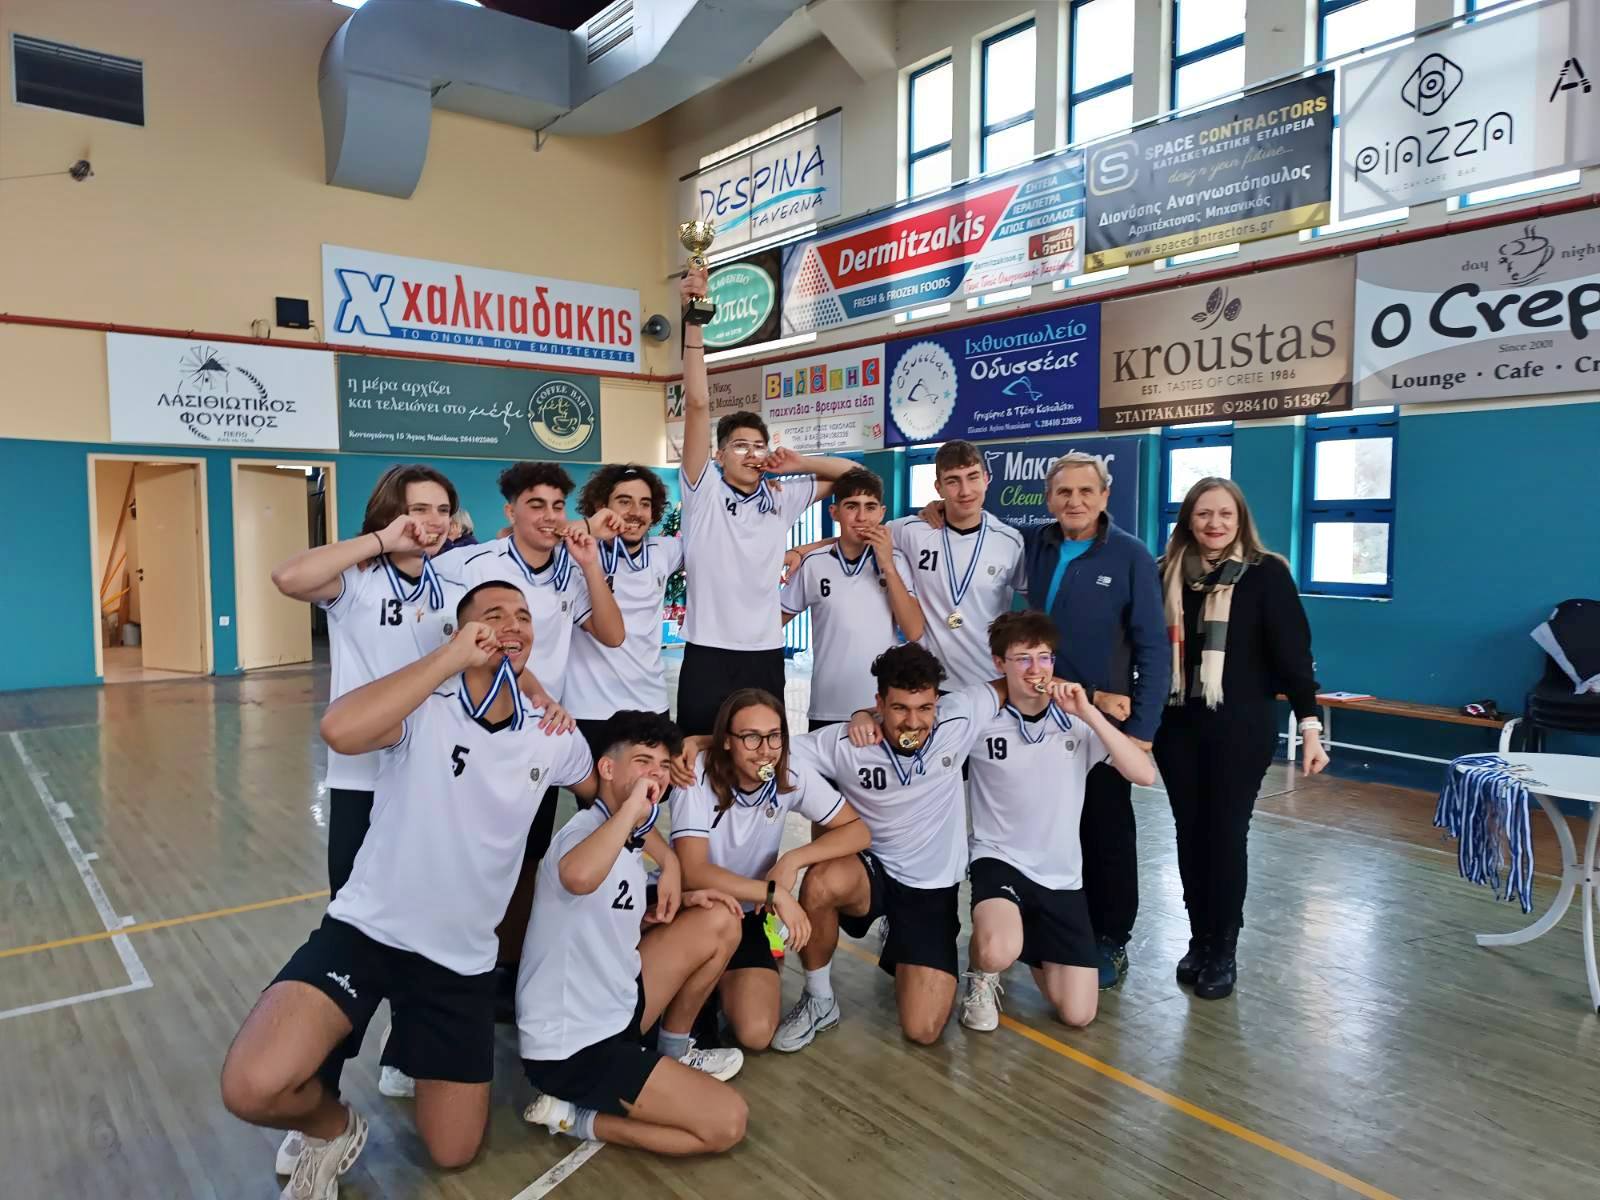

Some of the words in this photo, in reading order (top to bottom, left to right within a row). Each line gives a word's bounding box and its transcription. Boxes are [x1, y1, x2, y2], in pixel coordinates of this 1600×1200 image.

[1144, 134, 1194, 161] SPACE
[1198, 96, 1328, 145] CONTRACTORS
[1152, 136, 1250, 171] ΚΑΤΑΣΚΕΥΑΣΤΙΚΗ
[1256, 118, 1316, 143] ΕΤΑΙΡΕΙΑ
[699, 145, 825, 221] DESPINA
[1098, 201, 1162, 227] Διονύσης
[1166, 164, 1312, 211] Αναγνωστόπουλος
[752, 194, 824, 228] TAVERNA
[1128, 212, 1201, 237] Αρχιτέκτονας
[1205, 195, 1272, 219] Μηχανικός
[837, 210, 986, 277] Dermitzakis
[1124, 219, 1274, 260] www.spacecontractors.gr
[1461, 260, 1489, 272] day
[853, 293, 878, 308] FRESH
[878, 292, 885, 302] &
[886, 284, 918, 301] FROZEN
[919, 277, 951, 294] FOODS
[402, 328, 420, 341] ΤΟ
[430, 332, 486, 348] ΟΝΟΜΑ
[493, 337, 521, 351] ΠΟΥ
[530, 341, 634, 363] ΕΜΠΙΣΤΕΥΕΣΤΕ
[965, 319, 1087, 355] Ιχθυοπωλείο
[1498, 342, 1527, 353] Since
[970, 350, 1080, 380] Οδυσσέας
[1391, 371, 1467, 390] Lounge
[1494, 361, 1545, 381] Cafe
[348, 378, 358, 393] η
[362, 376, 398, 394] μέρα
[401, 380, 452, 397] αρχίζει
[536, 384, 568, 404] COFFEE
[570, 389, 587, 408] BAR
[1141, 383, 1162, 396] EST.
[1167, 379, 1203, 393] TASTES
[1207, 376, 1224, 388] OF
[1226, 372, 1264, 387] CRETE
[1271, 369, 1297, 382] 1986
[157, 392, 297, 413] ΛΑΣΙΘΙΩΤΙΚΟΣ
[348, 398, 372, 409] και
[375, 396, 440, 413] τελειώνει
[442, 404, 467, 414] στο
[1115, 402, 1215, 425] ΣΤΑΥΡΑΚΑΚΗΣ
[1235, 397, 1279, 414] 28410
[1283, 391, 1331, 409] 51362
[179, 411, 279, 429] ΦΟΥΡΝΟΣ
[1000, 486, 1043, 506] Clean
[919, 549, 937, 571] 21
[820, 578, 831, 598] 6
[379, 598, 403, 626] 13
[450, 744, 470, 778] 5
[985, 736, 1008, 760] 19
[858, 767, 887, 790] 30
[611, 880, 635, 910] 22
